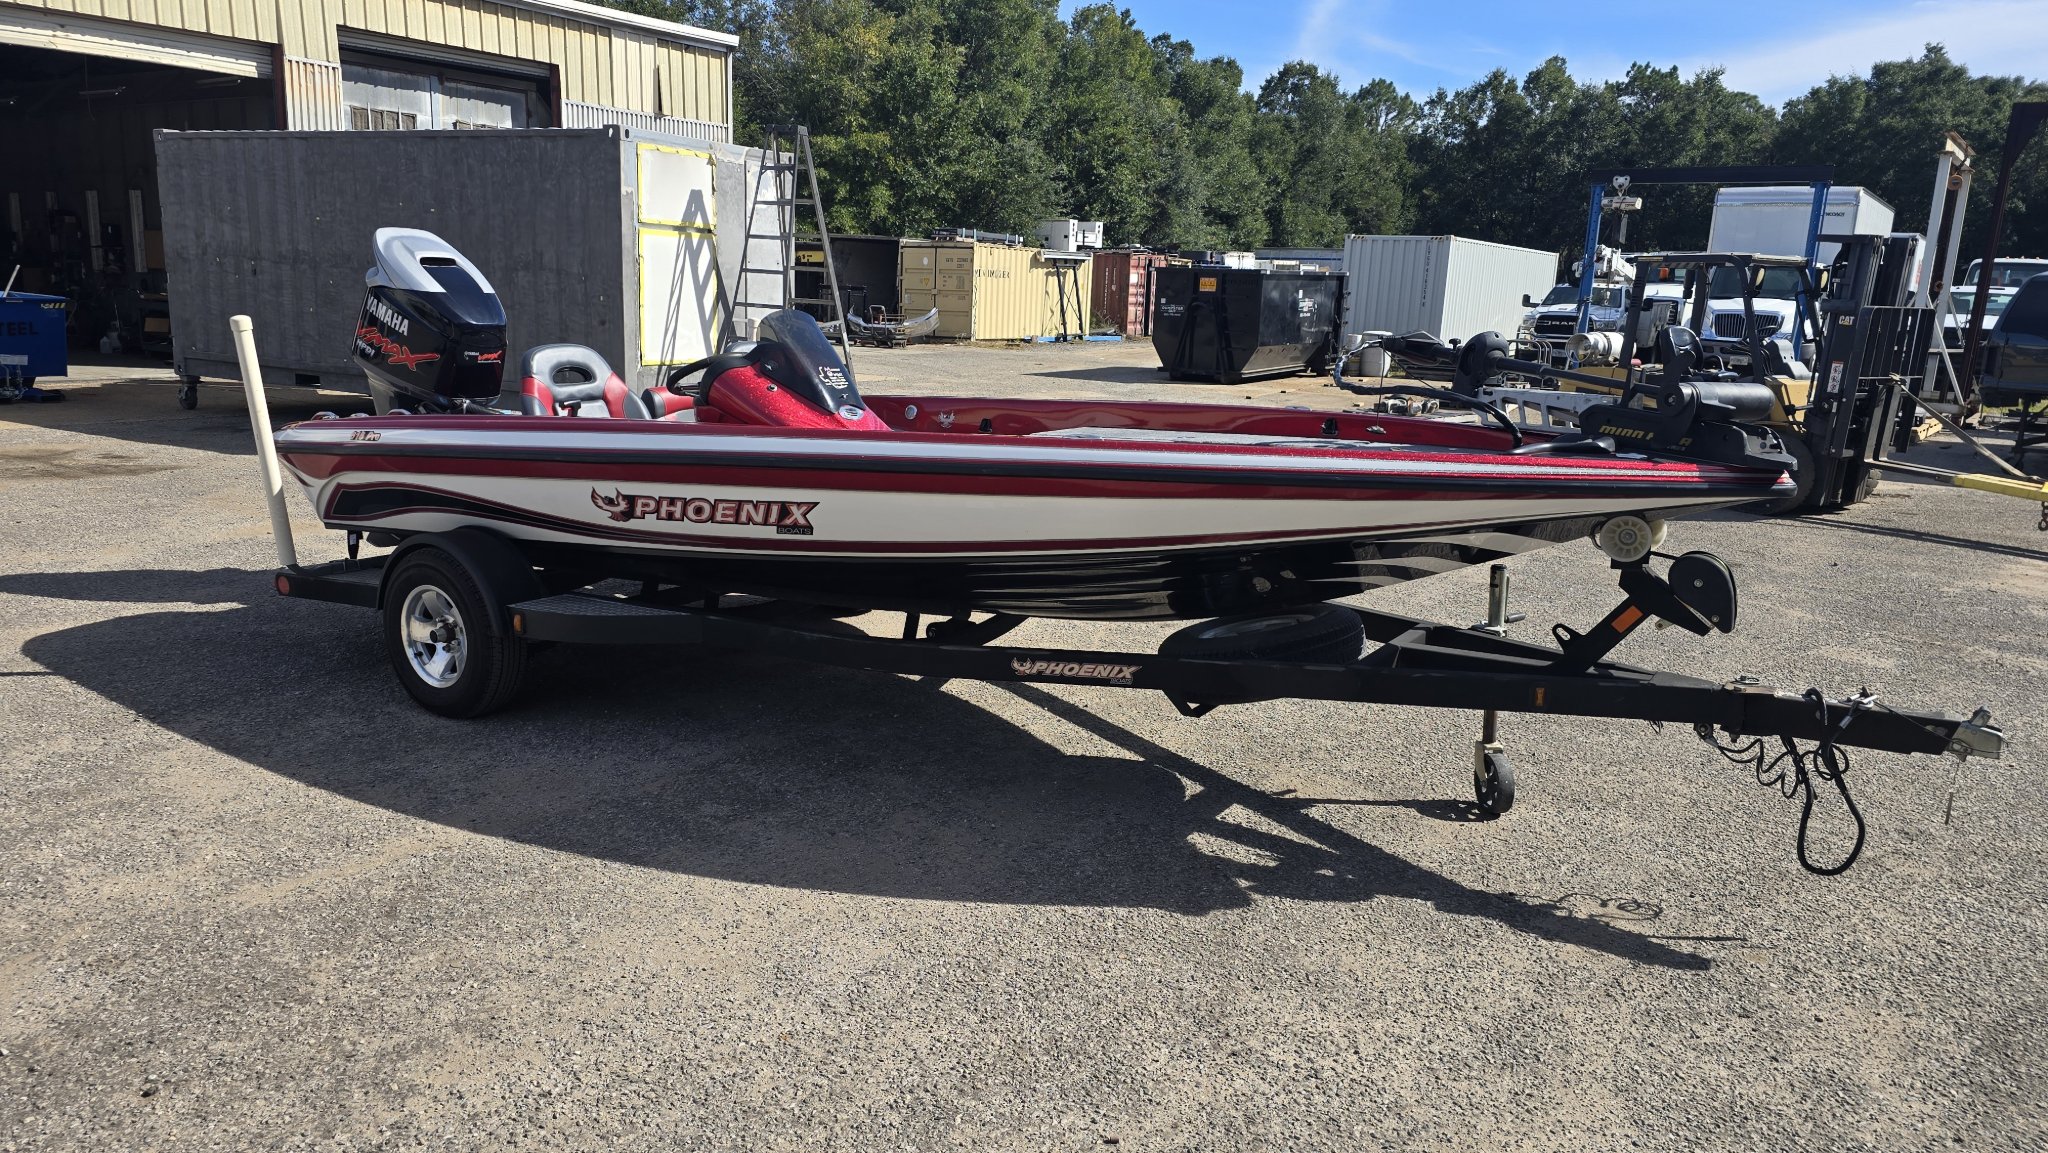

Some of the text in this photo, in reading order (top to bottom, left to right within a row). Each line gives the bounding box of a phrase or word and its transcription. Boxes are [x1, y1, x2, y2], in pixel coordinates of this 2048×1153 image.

[366, 294, 409, 336] YAMAHA
[1839, 315, 1855, 326] CAT
[356, 339, 376, 358] HPDI
[633, 496, 819, 526] PHOENIX
[777, 526, 813, 535] BOATS
[1030, 660, 1142, 679] PHOENIX
